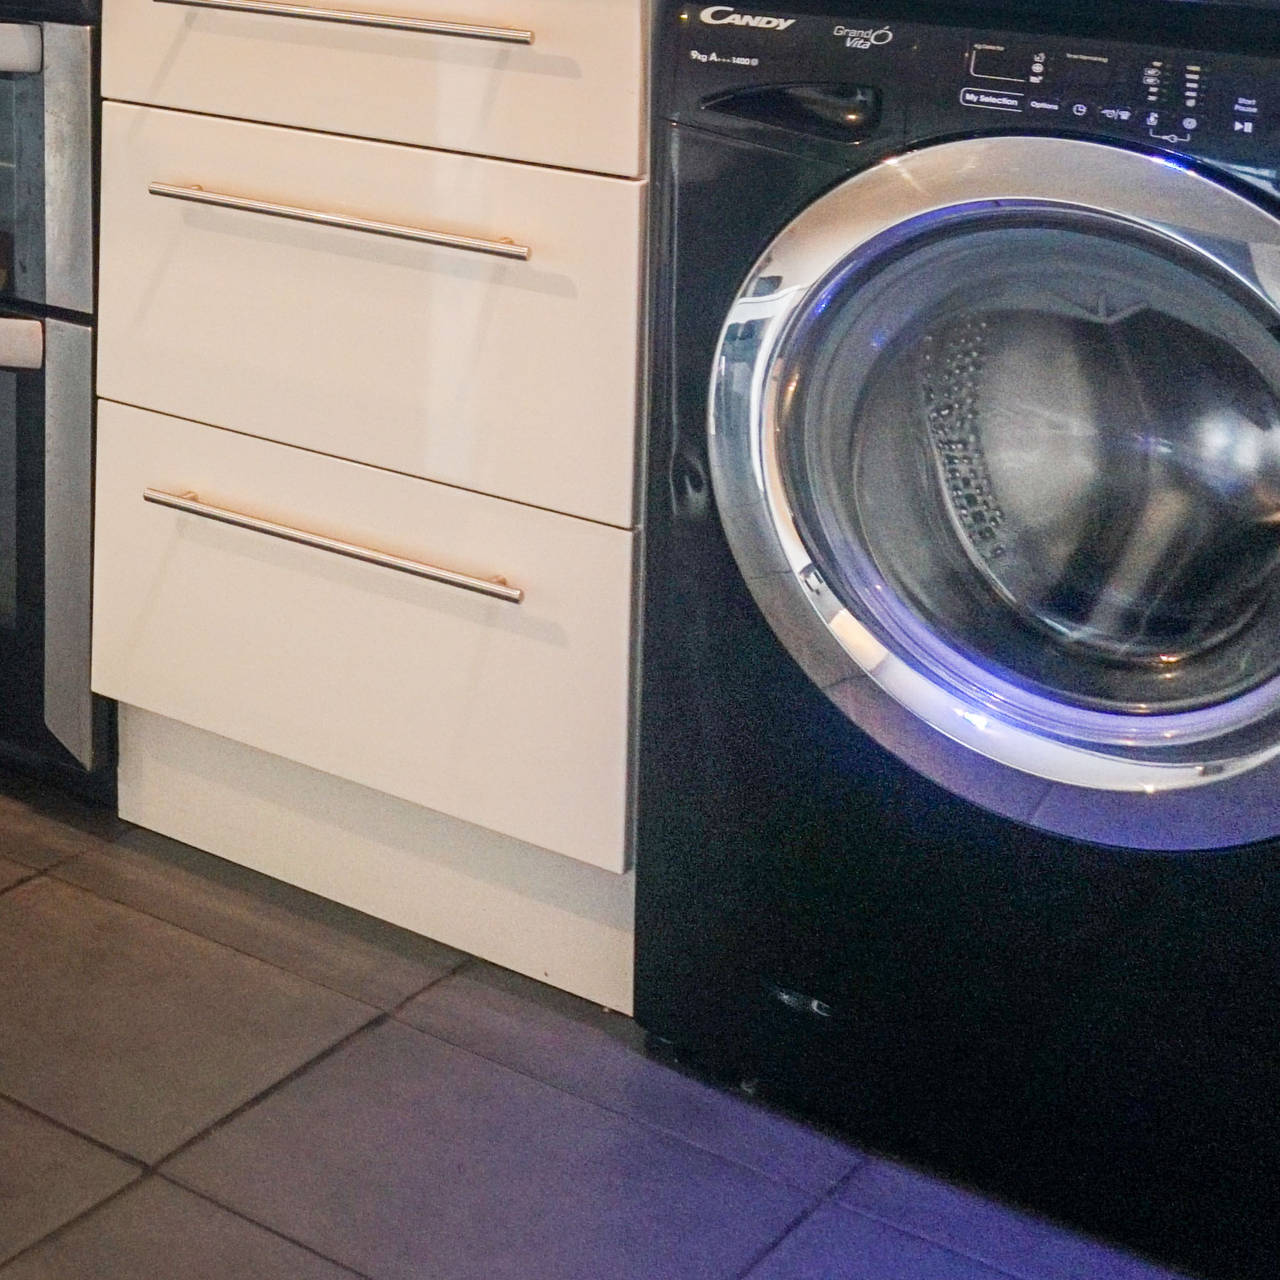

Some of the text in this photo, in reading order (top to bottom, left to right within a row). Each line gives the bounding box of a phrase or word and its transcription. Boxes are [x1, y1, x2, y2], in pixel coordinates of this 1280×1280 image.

[845, 36, 872, 50] Vita
[980, 94, 1019, 106] Selection
[1030, 100, 1059, 111] Options
